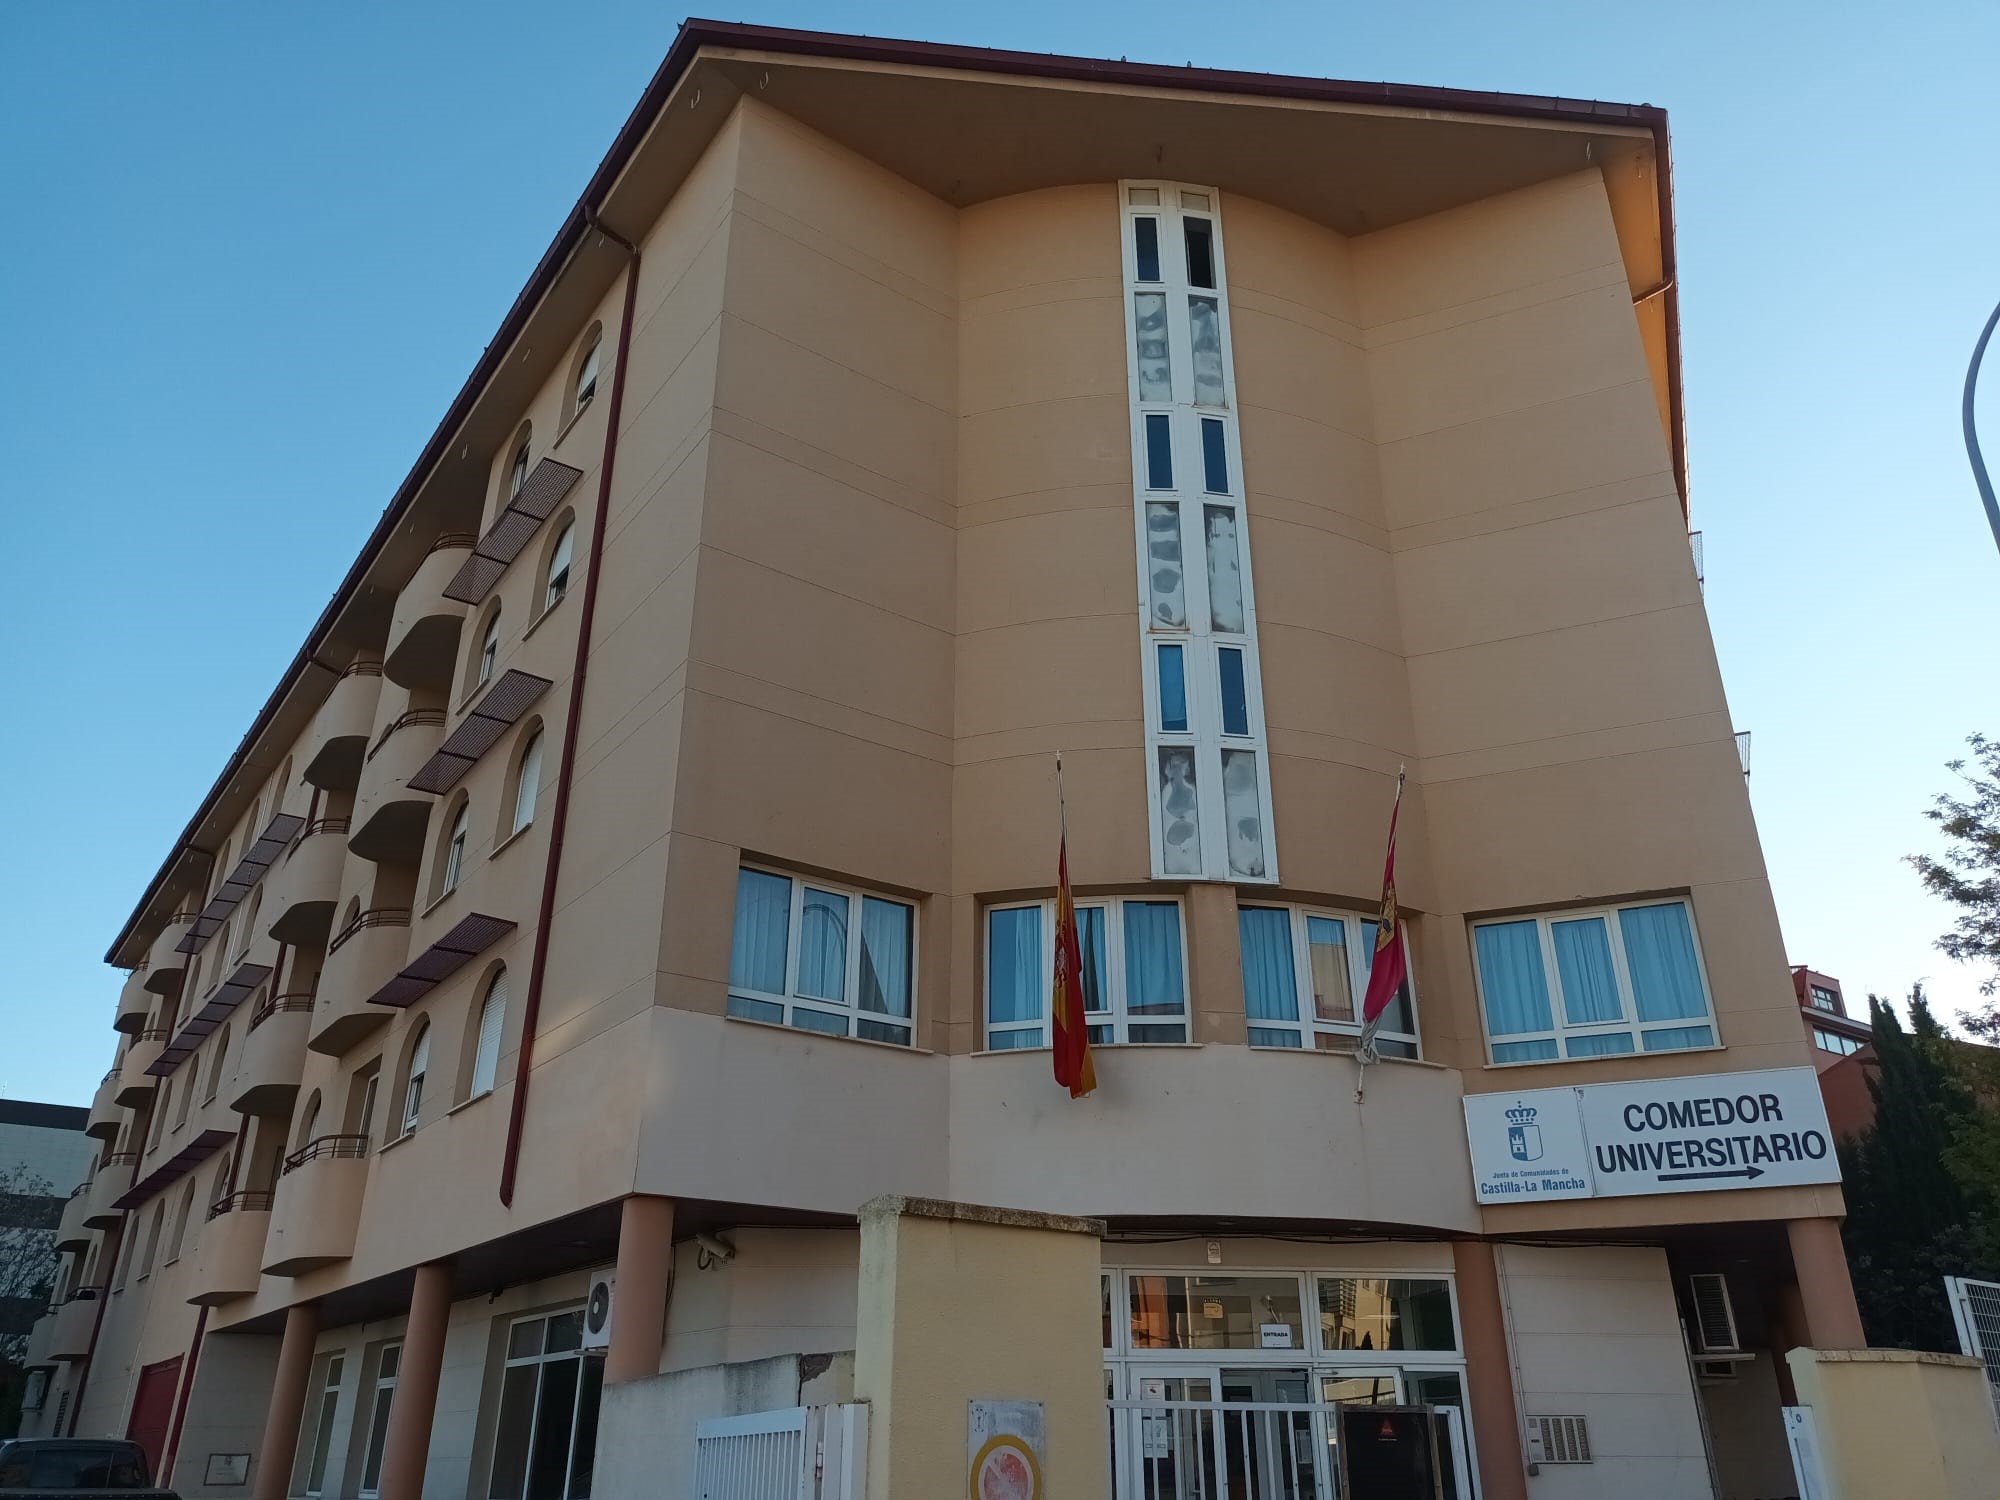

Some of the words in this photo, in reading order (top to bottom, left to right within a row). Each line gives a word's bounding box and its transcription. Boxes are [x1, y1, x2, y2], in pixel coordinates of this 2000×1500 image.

[1624, 1094, 1783, 1132] COMEDOR
[1596, 1130, 1827, 1173] UNIVERSITARIO
[1481, 1181, 1537, 1195] Castilla-La
[1542, 1178, 1585, 1191] Mancha
[1493, 1171, 1509, 1179] Junta
[1520, 1168, 1560, 1177] Comunidades
